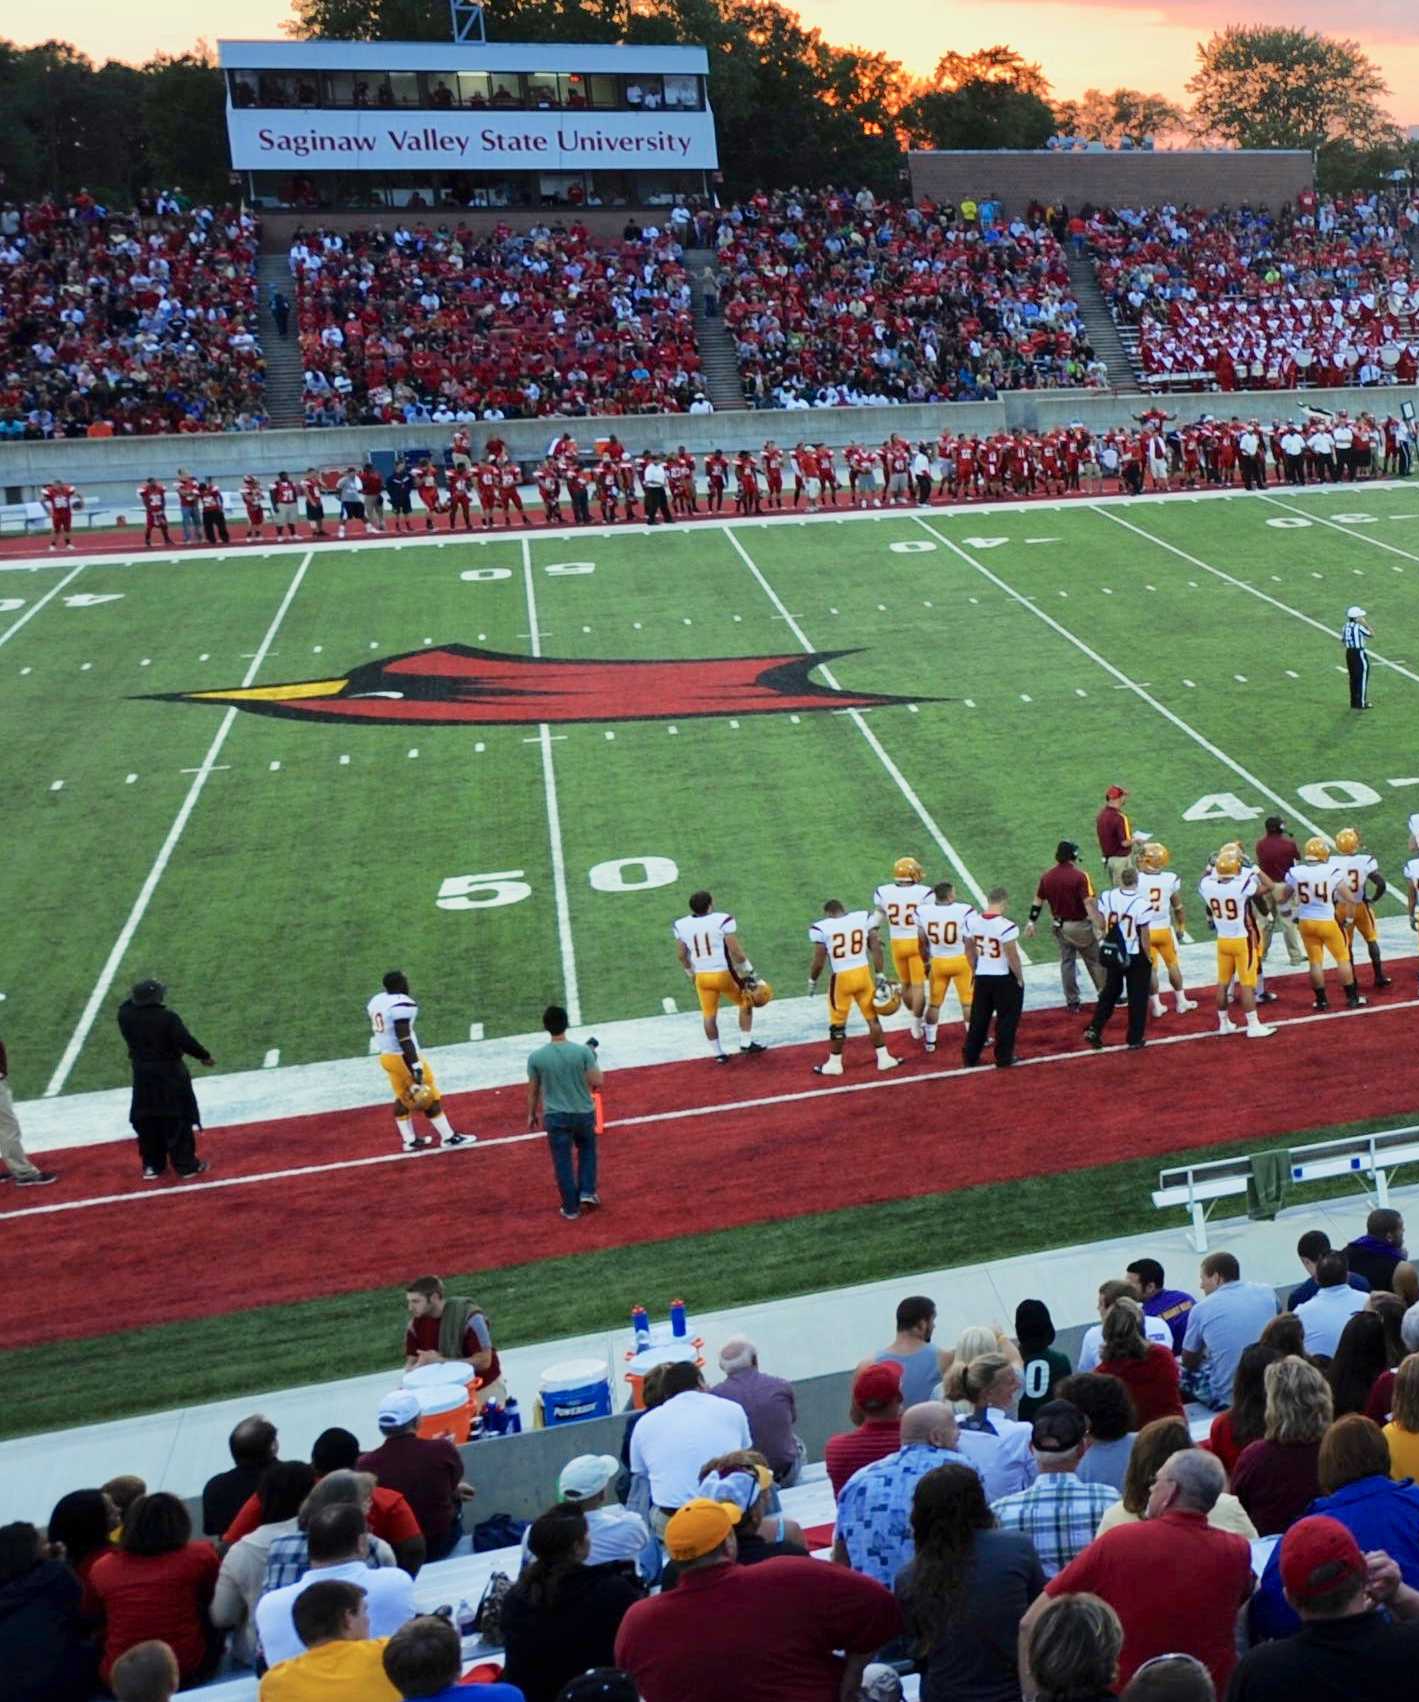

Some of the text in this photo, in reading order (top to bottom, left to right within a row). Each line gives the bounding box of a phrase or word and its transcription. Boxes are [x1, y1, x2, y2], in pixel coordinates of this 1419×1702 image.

[258, 128, 692, 158] Saginaw Valley State University
[1181, 780, 1383, 822] 40
[435, 856, 680, 910] 50
[1297, 881, 1328, 904] 54
[888, 904, 917, 926] 22
[694, 932, 713, 958] 11
[833, 929, 864, 958] 28
[927, 921, 957, 945] 50
